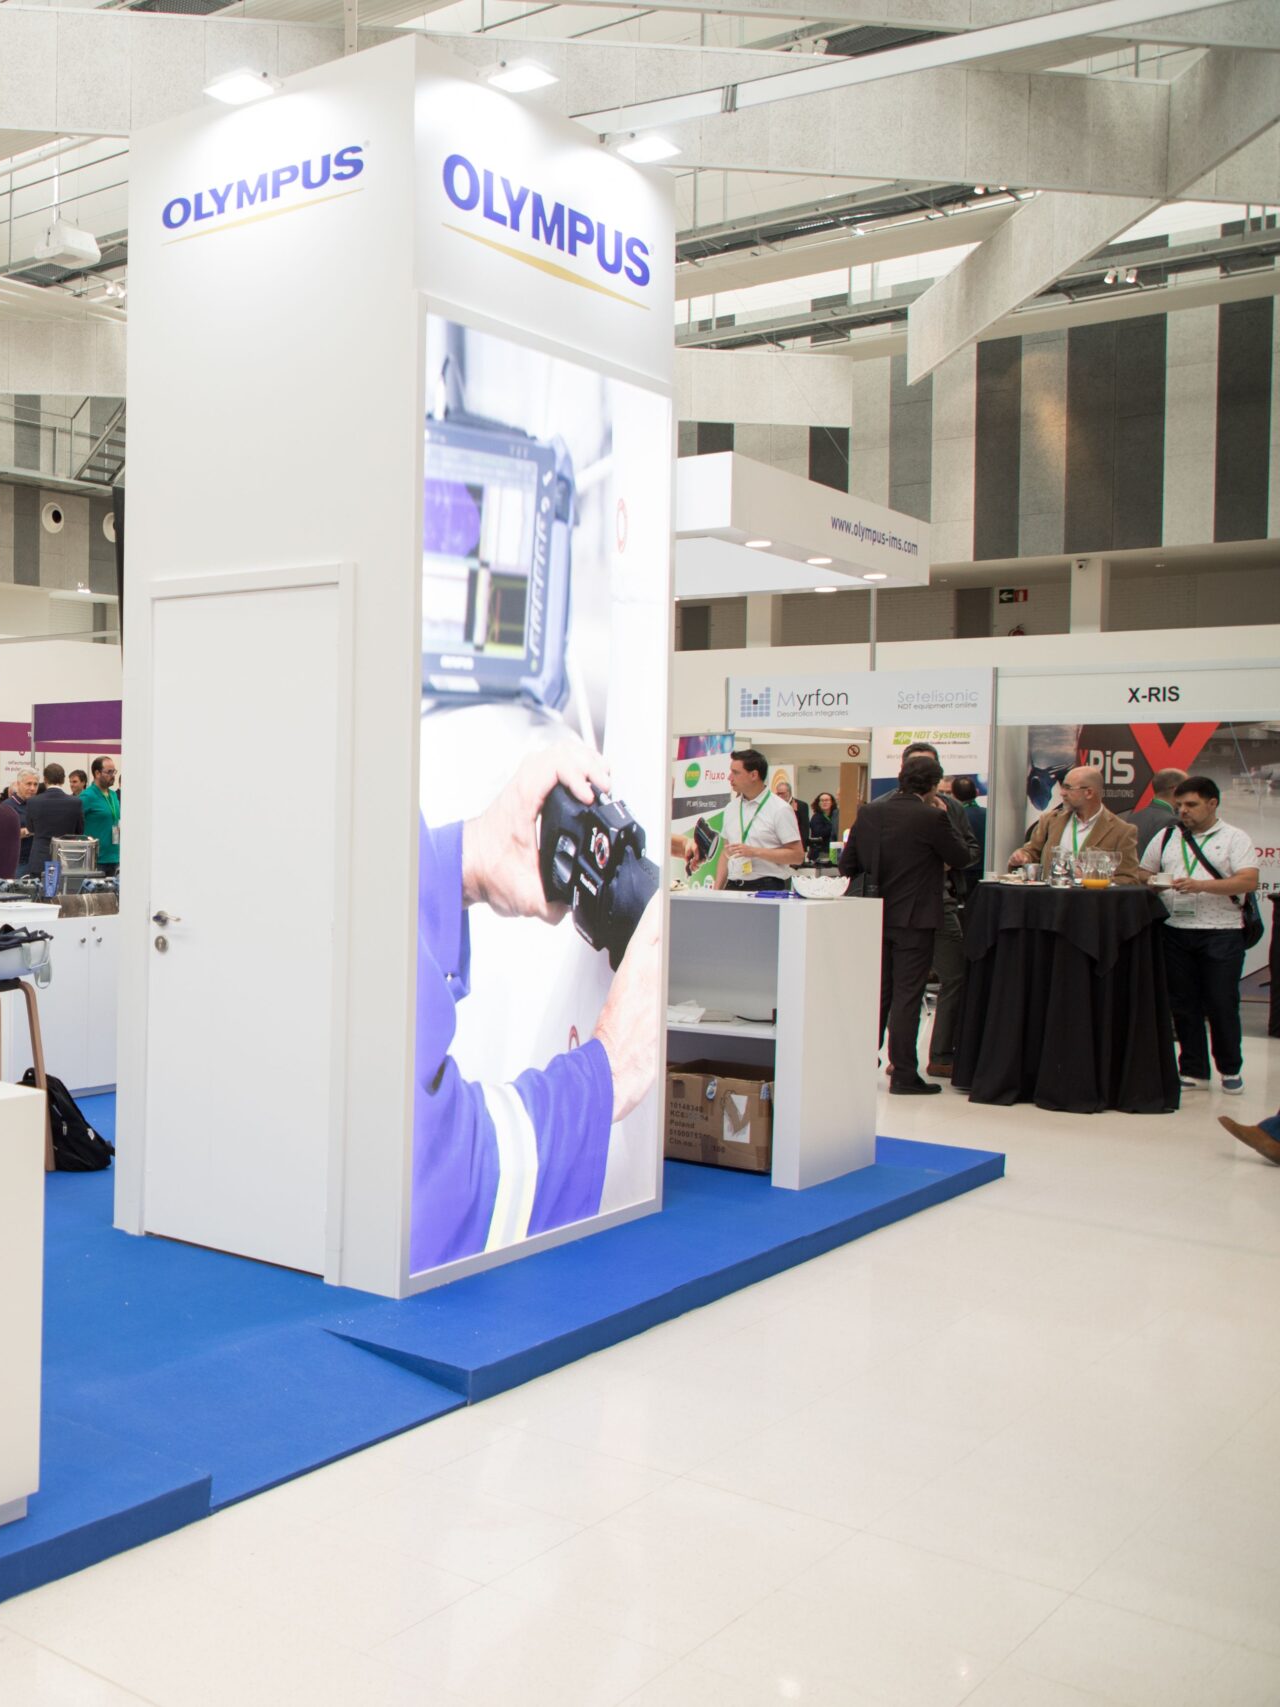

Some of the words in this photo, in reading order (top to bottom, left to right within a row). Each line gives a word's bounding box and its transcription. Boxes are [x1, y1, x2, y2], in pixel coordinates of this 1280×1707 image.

[161, 145, 365, 231] OLYMPUS
[442, 153, 652, 287] OLYMPUS
[830, 515, 918, 556] www.olympus-ims.com
[777, 688, 849, 711] Myrfon
[897, 689, 979, 704] Setelisonic
[1128, 685, 1180, 703] X-RIS
[913, 702, 953, 710] equipment
[954, 701, 978, 709] online
[913, 731, 930, 739] NDT
[932, 731, 971, 741] Systems
[705, 770, 726, 781] Fluxo
